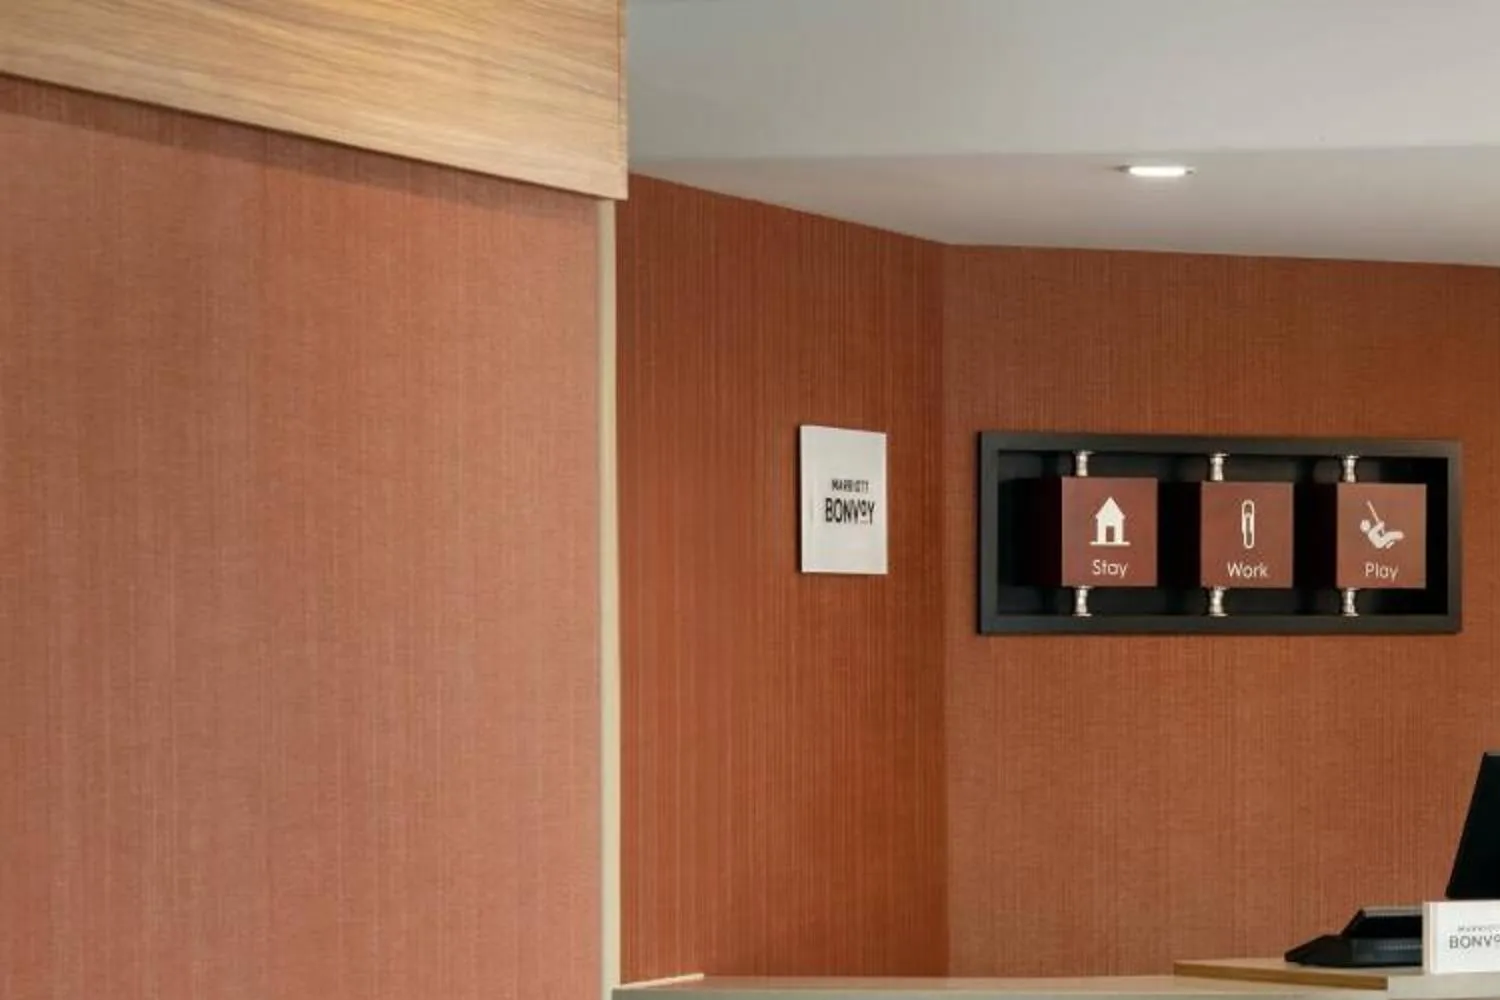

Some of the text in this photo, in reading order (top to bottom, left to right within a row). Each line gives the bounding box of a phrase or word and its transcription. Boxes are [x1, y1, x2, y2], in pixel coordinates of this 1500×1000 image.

[825, 498, 875, 525] BONVOY
[1092, 559, 1128, 579] Stay
[1227, 561, 1269, 578] Work
[1365, 561, 1399, 581] Play
